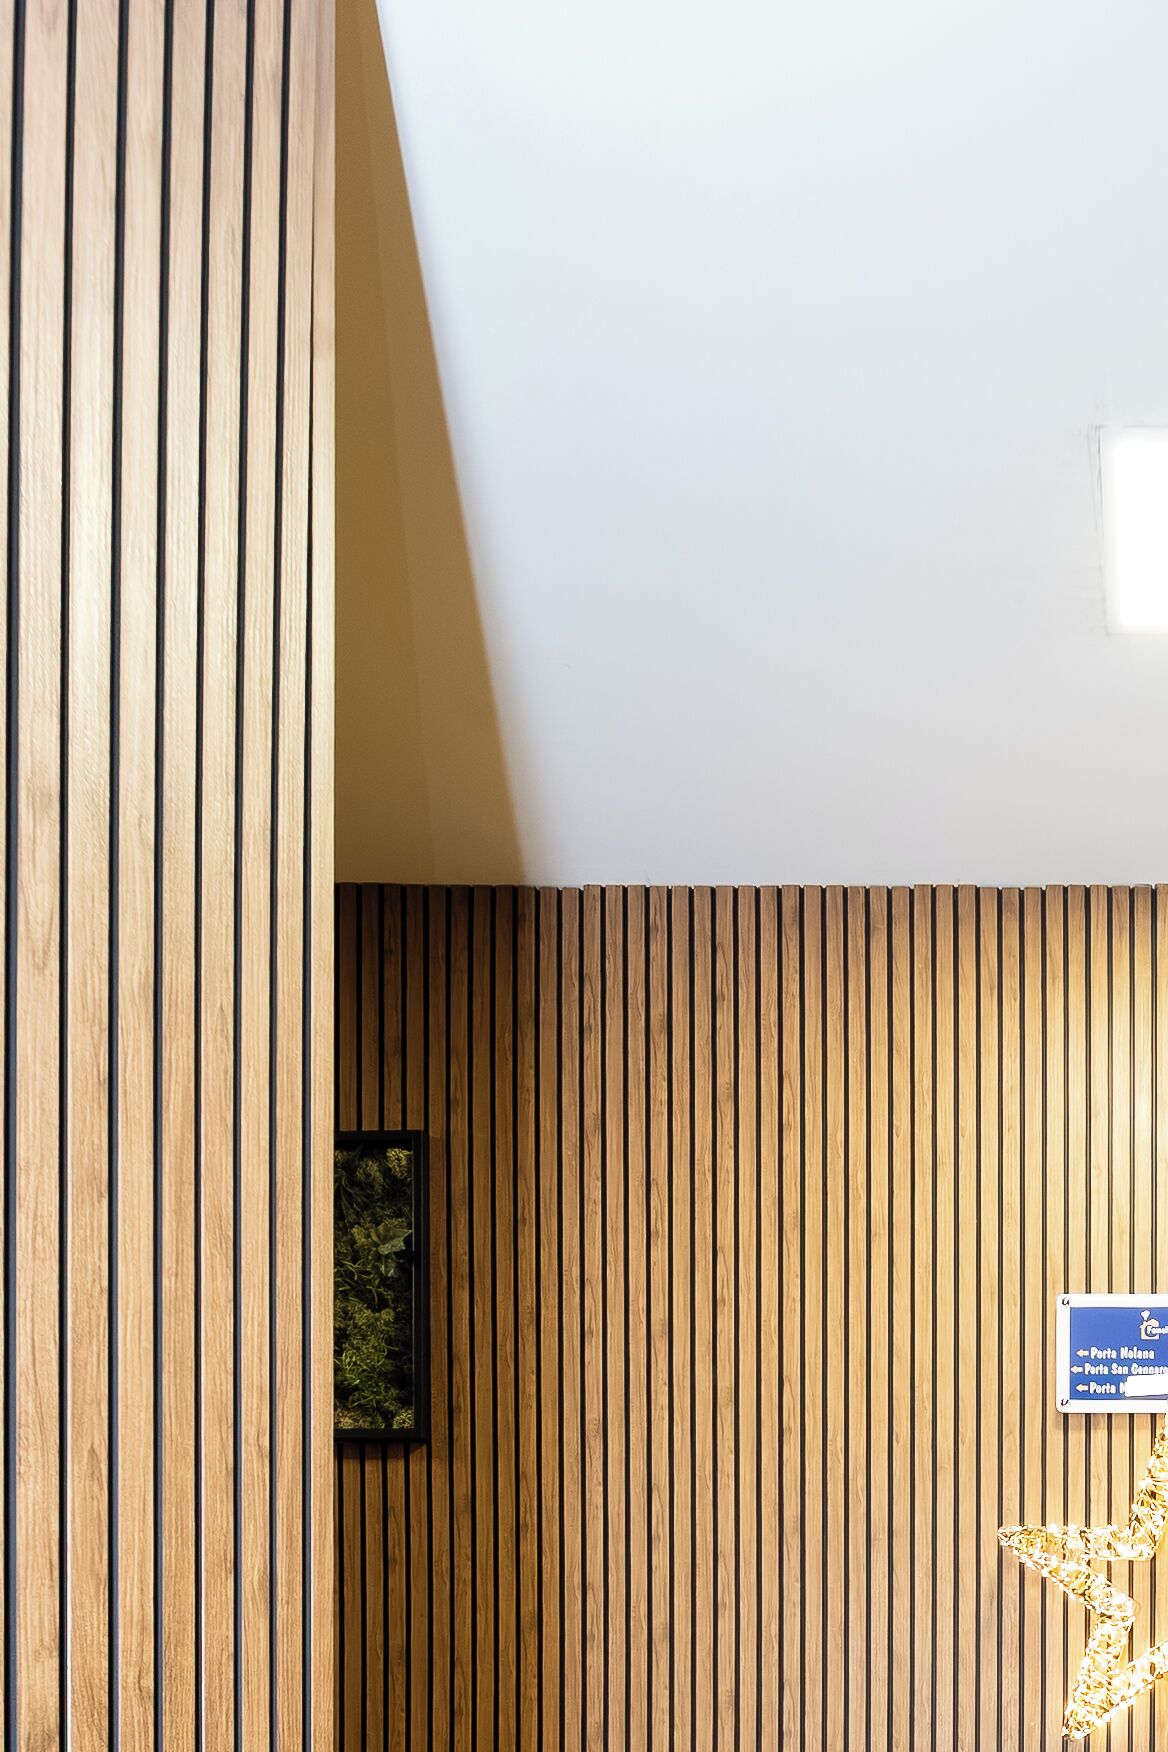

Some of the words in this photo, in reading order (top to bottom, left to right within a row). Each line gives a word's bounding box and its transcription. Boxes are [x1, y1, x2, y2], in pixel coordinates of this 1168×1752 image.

[1090, 1346, 1117, 1360] Porta
[1120, 1346, 1155, 1360] Nolana
[1084, 1362, 1109, 1375] Porta
[1111, 1362, 1129, 1375] San
[1131, 1362, 1168, 1375] Gennaro
[1089, 1381, 1116, 1394] Porta
